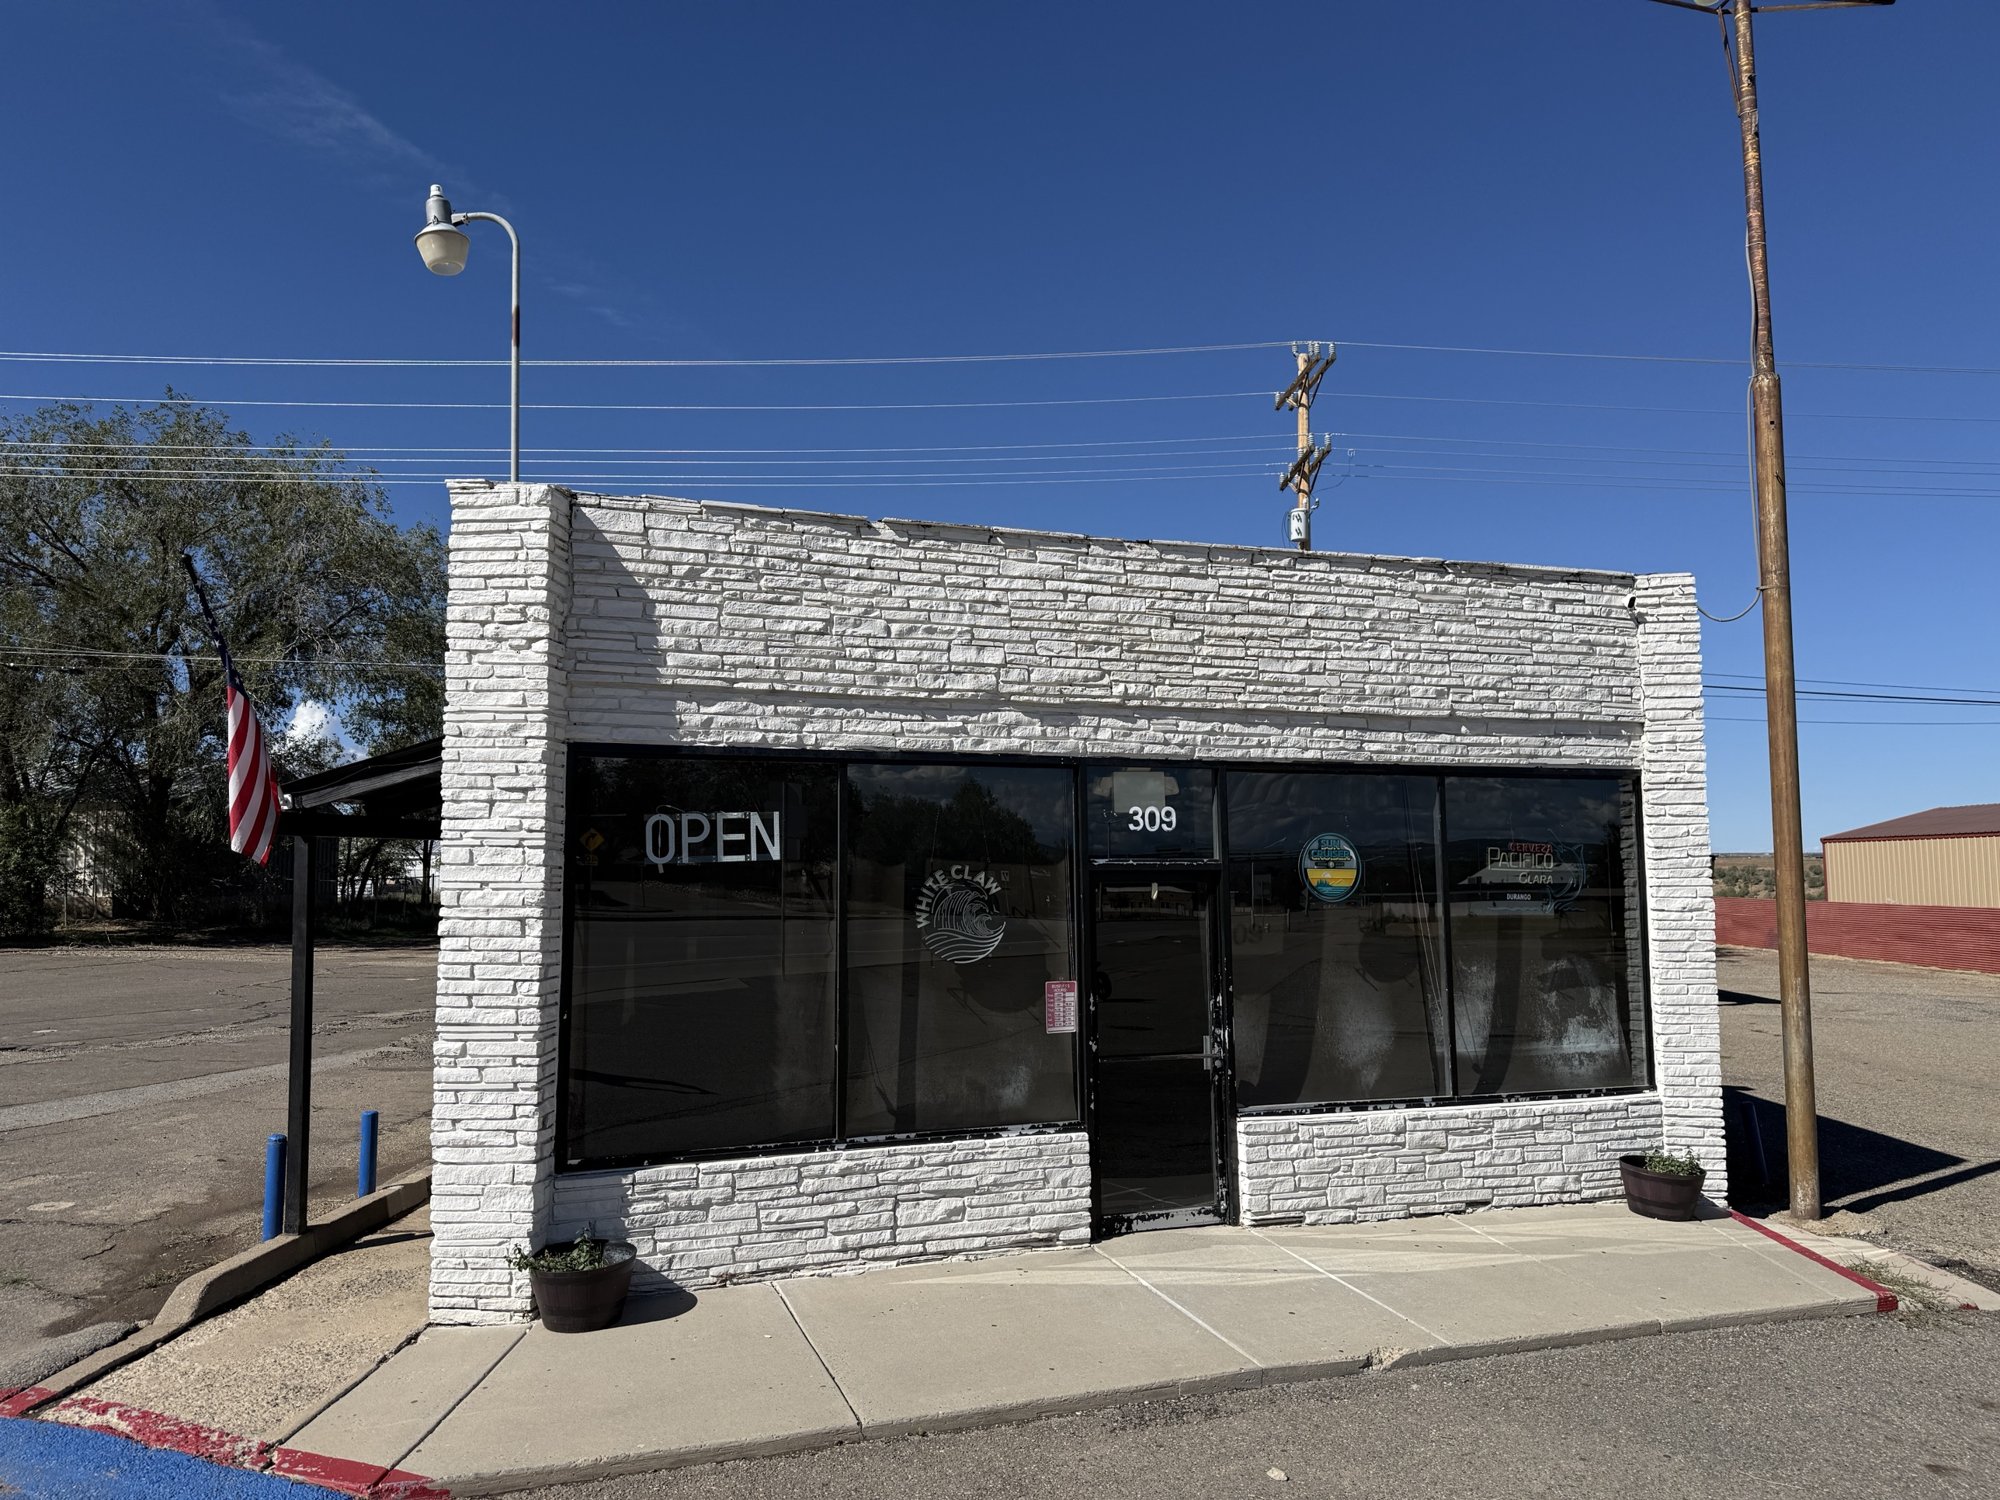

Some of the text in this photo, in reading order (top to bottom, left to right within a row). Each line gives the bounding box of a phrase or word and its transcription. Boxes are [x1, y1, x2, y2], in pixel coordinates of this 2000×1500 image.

[1128, 806, 1177, 832] 309
[645, 811, 781, 864] OPEN
[1319, 839, 1341, 850] SUN
[1509, 842, 1553, 853] CERVEZA
[1310, 849, 1352, 861] CRUISER
[1487, 847, 1554, 870] PACIFICO
[1518, 872, 1554, 885] CLARA
[915, 864, 1002, 929] WHITE CLAW
[1506, 893, 1532, 901] DURANGO
